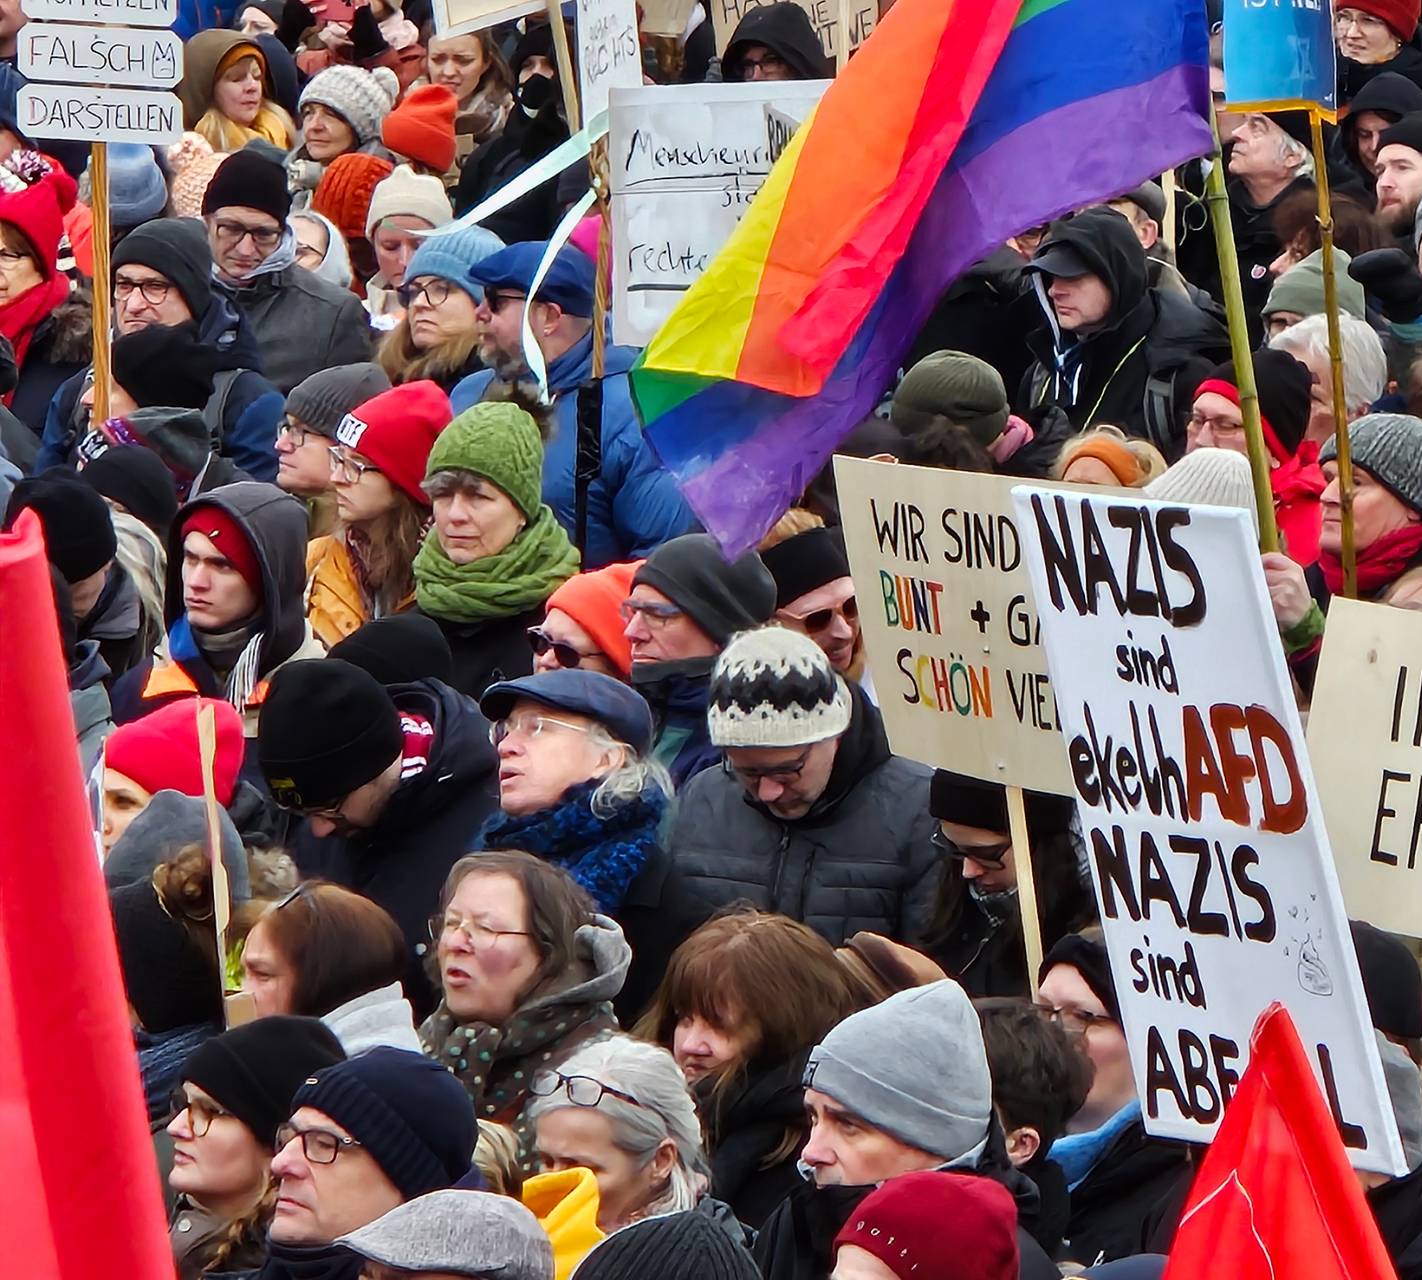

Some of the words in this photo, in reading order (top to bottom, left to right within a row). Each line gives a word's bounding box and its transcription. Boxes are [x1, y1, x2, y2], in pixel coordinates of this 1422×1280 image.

[29, 35, 146, 72] FALSCH
[27, 96, 174, 132] DARSTELLEN
[870, 498, 930, 564] WIR
[941, 508, 1021, 572] SIND
[1030, 493, 1208, 628] NAZIS
[880, 569, 944, 636] BUNT
[896, 648, 993, 719] SCHÖN
[1116, 630, 1180, 696] sind
[1068, 699, 1309, 835] ekelhAFD
[1090, 825, 1278, 944] NAZIS
[1130, 934, 1207, 1010] sind
